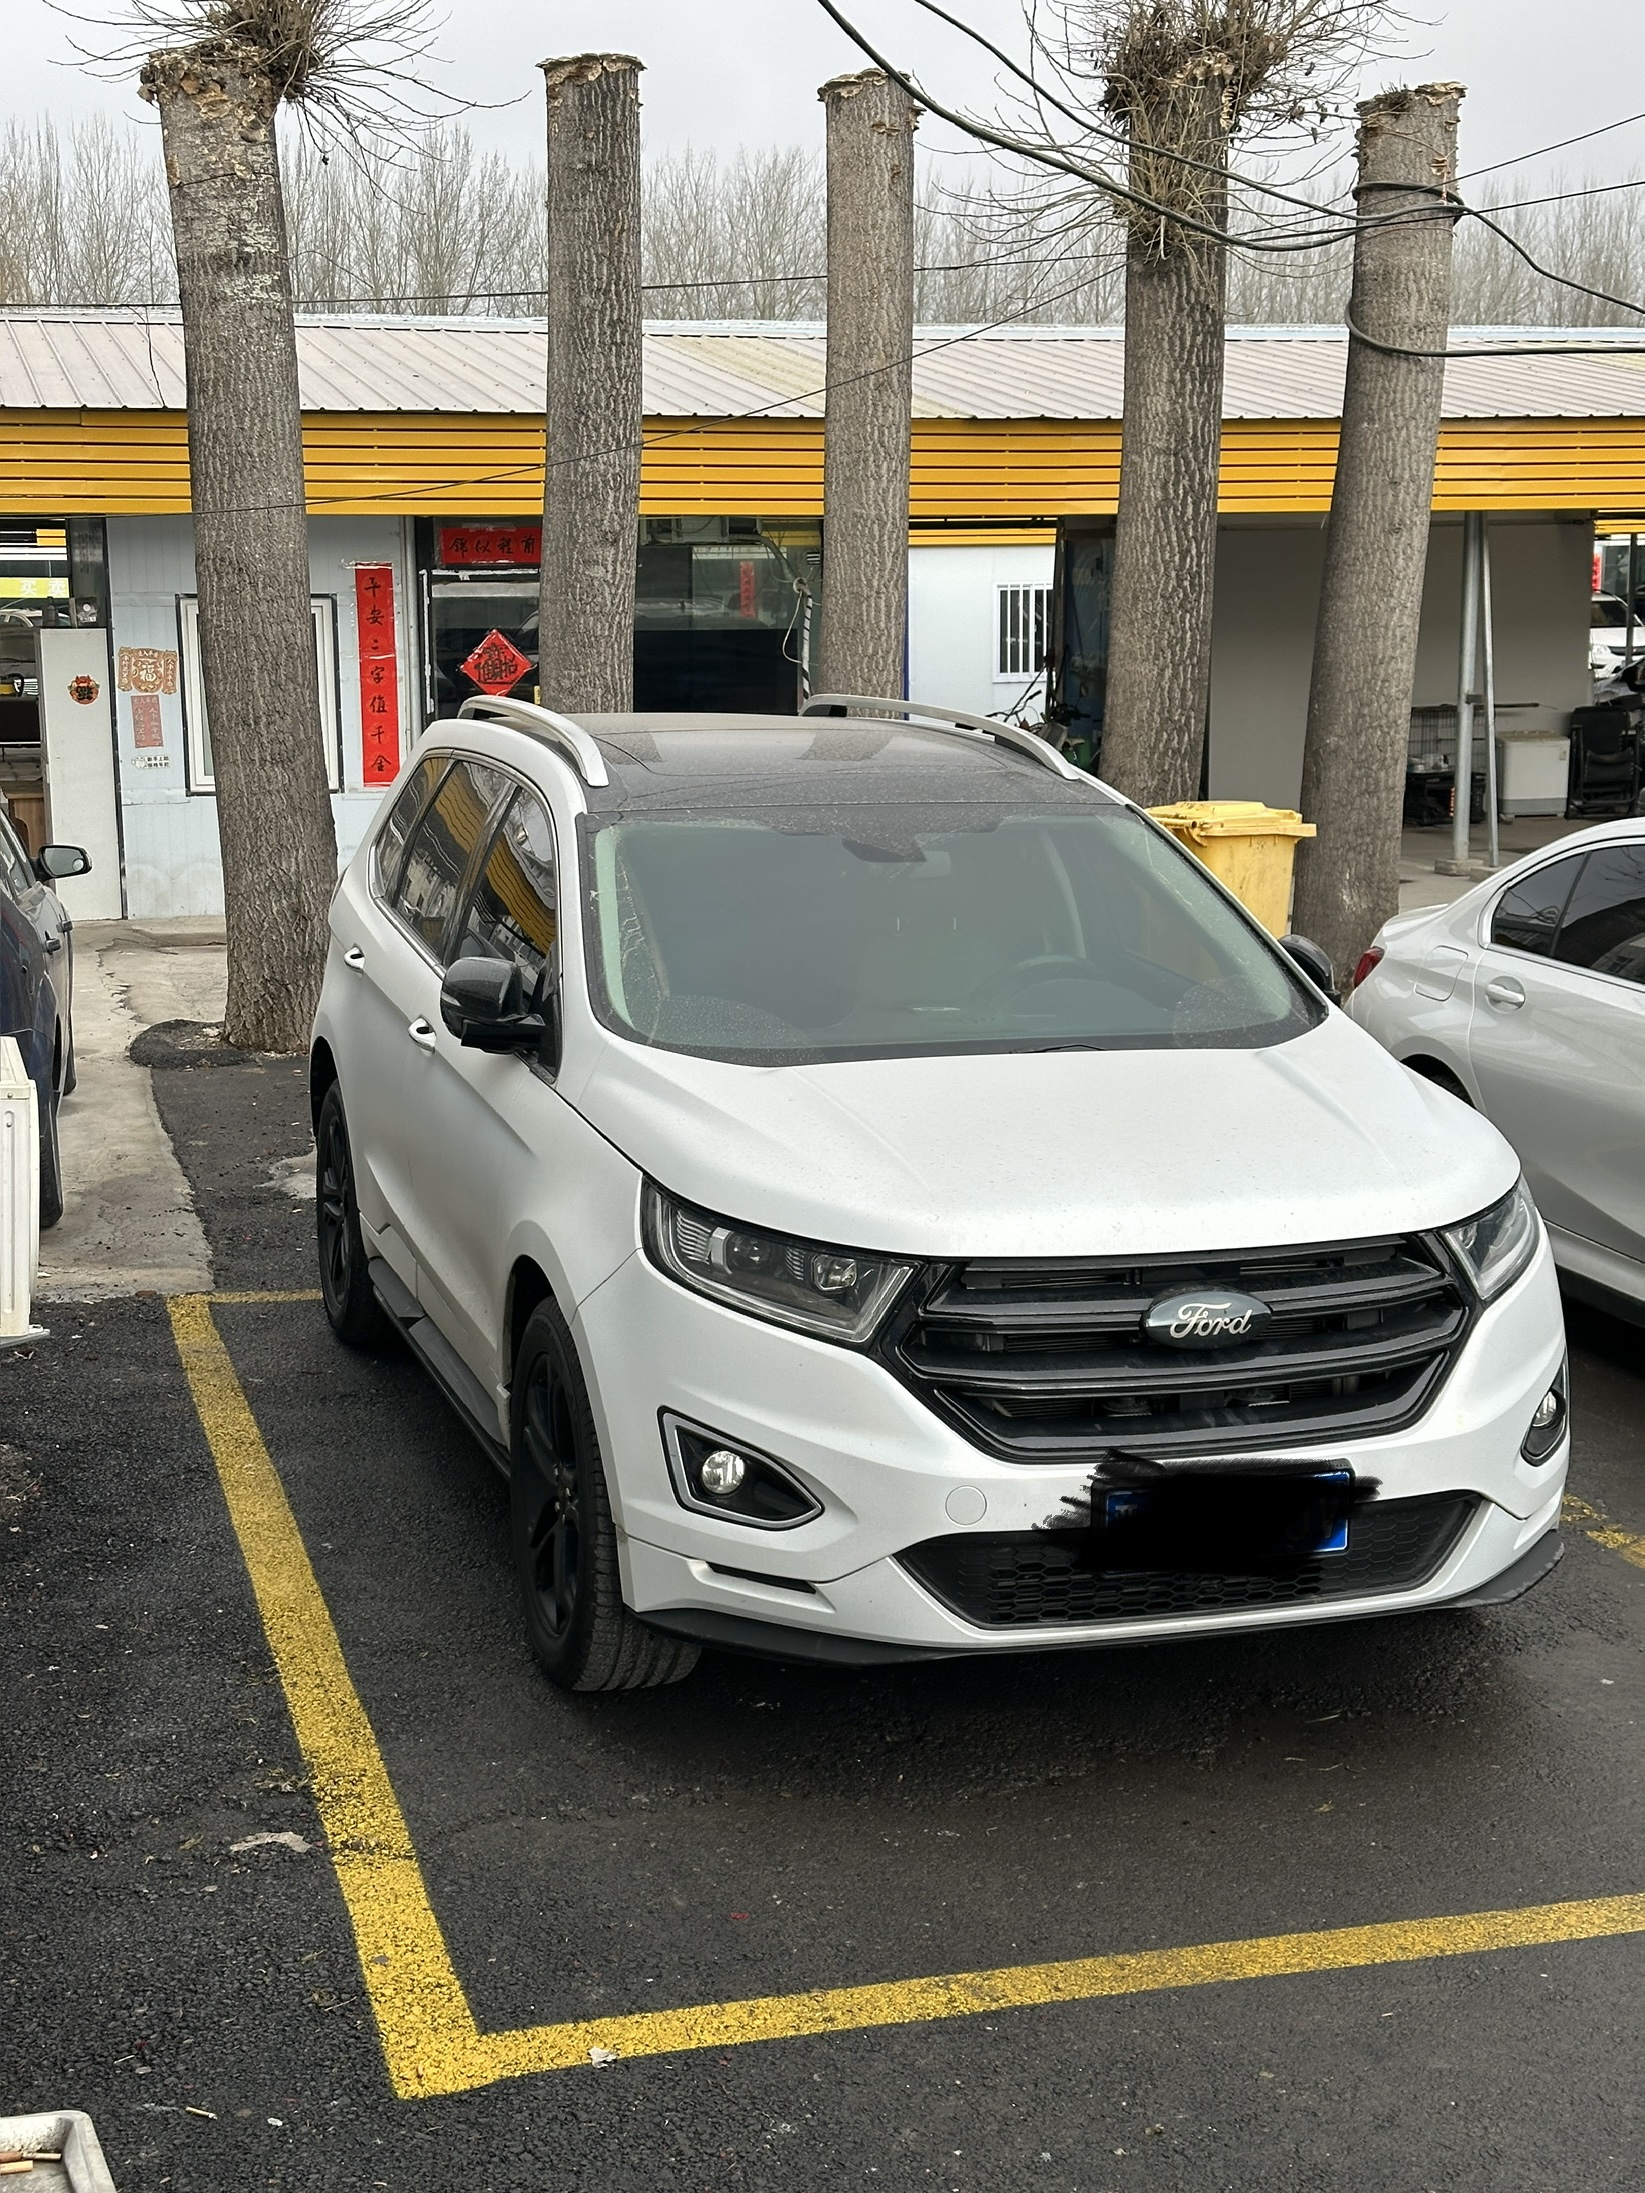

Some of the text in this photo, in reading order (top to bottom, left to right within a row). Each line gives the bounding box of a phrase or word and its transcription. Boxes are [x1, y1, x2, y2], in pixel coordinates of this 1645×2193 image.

[139, 662, 157, 682] 福
[364, 576, 392, 772] 平安二字值千金
[1170, 1302, 1253, 1339] Ford
